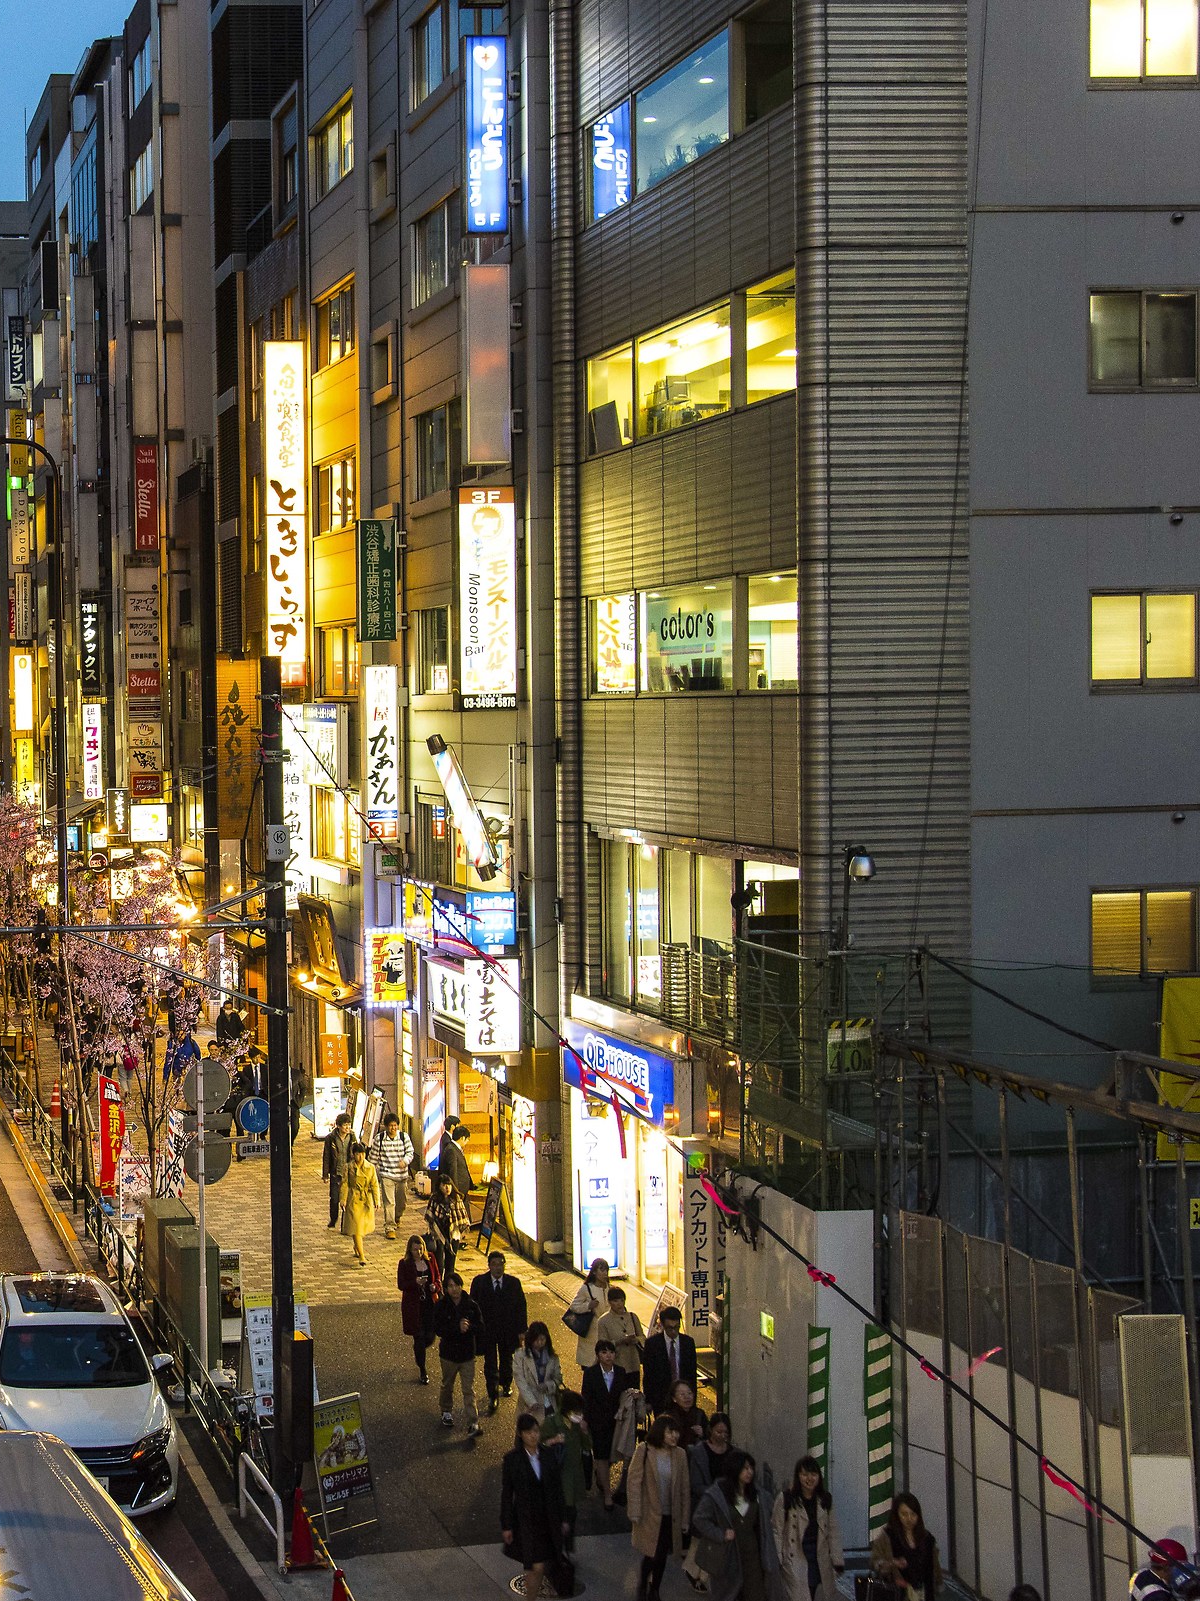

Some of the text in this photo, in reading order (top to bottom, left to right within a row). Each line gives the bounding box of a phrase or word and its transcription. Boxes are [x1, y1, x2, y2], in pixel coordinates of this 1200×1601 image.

[474, 213, 501, 226] 5F
[11, 333, 24, 382] ドルフィン
[137, 479, 153, 519] Stella
[471, 491, 501, 504] 3F
[140, 534, 156, 546] 4F
[270, 479, 304, 653] ときしらず
[366, 524, 381, 638] 渋谷矯正歯科診療所
[468, 573, 481, 644] Monsoon
[660, 607, 714, 641] color's
[82, 614, 98, 682] ナタックス
[465, 645, 486, 656] Bar
[130, 675, 158, 687] Stella
[463, 697, 516, 709] 03-3498-6876
[132, 738, 159, 746] てもみん
[367, 725, 396, 806] かあさん
[370, 821, 397, 837] 3F
[473, 896, 515, 909] Barber
[483, 933, 505, 944] 2F
[372, 935, 388, 1001] ゴーゴーカレー
[476, 964, 498, 1047] 富士そば
[689, 1187, 710, 1328] ヘアカット専門店
[333, 1466, 368, 1482] カイトリマン
